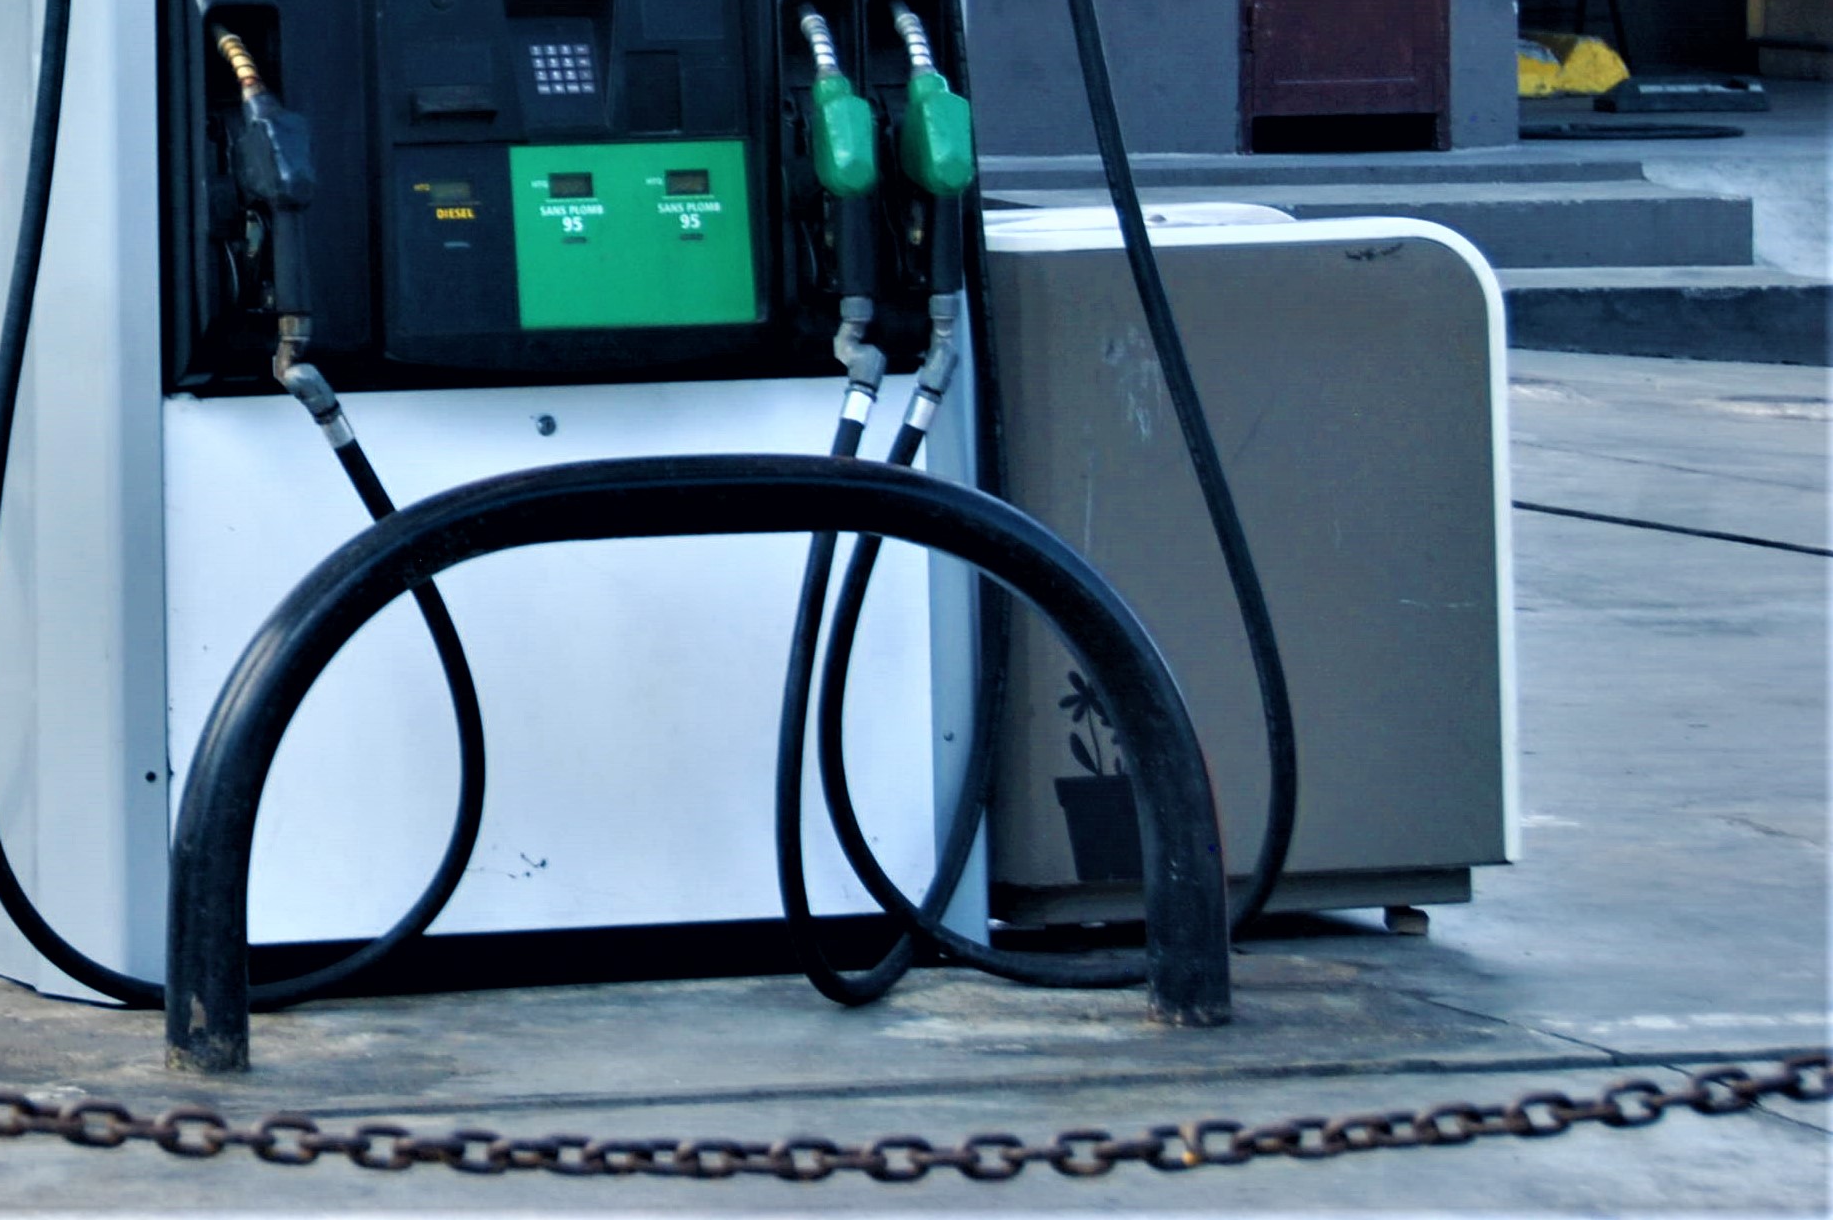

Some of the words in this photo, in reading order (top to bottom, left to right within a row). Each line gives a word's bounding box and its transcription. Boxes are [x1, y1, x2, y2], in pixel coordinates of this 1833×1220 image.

[436, 207, 476, 220] DIESEL
[540, 205, 566, 216] SANS
[569, 204, 604, 215] PLOMB
[657, 202, 684, 214] SANS
[686, 201, 720, 213] PLOMB
[562, 216, 583, 232] 95
[679, 213, 701, 229] 95
